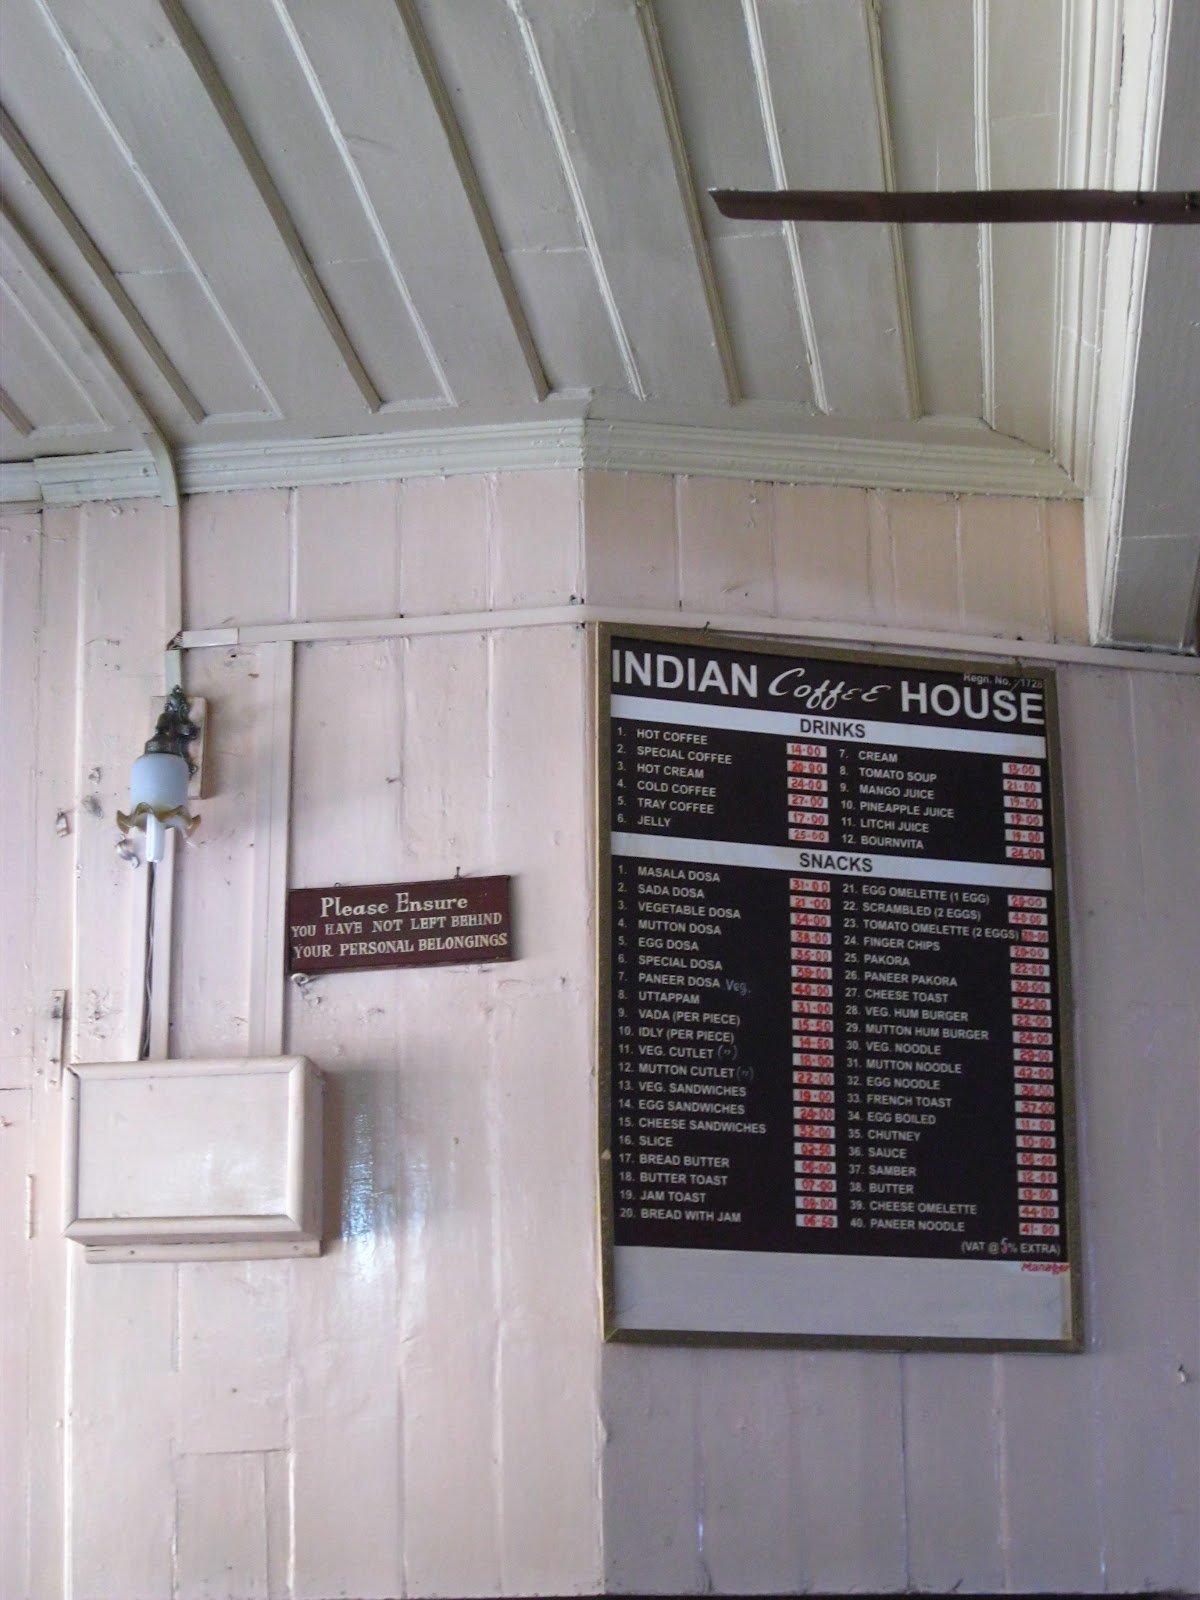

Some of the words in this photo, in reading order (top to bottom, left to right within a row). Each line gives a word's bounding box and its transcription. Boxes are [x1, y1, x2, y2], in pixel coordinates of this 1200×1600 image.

[612, 649, 758, 698] INDIAN
[901, 680, 1045, 725] HOUSE
[617, 727, 626, 736] 1.
[637, 729, 661, 740] HOT
[663, 731, 708, 745] COFFEE
[800, 719, 866, 739] DRINKS
[617, 744, 626, 754] 2.
[637, 746, 685, 760] SPECIAL
[687, 751, 732, 765] COFFEE
[839, 749, 848, 759] 7.
[858, 750, 898, 763] CREAM
[617, 762, 626, 771] 3.
[637, 763, 661, 775] HOT
[663, 766, 704, 779] CREAM
[839, 766, 848, 775] 8.
[859, 767, 904, 781] TOMATO
[907, 771, 937, 783] SOUP
[617, 779, 626, 788] 4.
[637, 781, 668, 793] COLD
[671, 784, 717, 797] COFFEE
[840, 783, 849, 793] 9.
[859, 784, 901, 797] MANGO
[903, 788, 934, 800] JUICE
[617, 796, 626, 806] 5.
[637, 798, 667, 810] TRAY
[669, 801, 714, 814] COFFEE
[841, 800, 855, 810] 10.
[859, 801, 920, 816] PINEAPPLE
[923, 806, 955, 818] JUICE
[617, 814, 626, 823] 6.
[637, 816, 671, 828] JELLY
[841, 817, 856, 827] 11.
[860, 818, 895, 831] LITCHI
[898, 821, 929, 833] JUICE
[841, 834, 856, 844] 12.
[861, 836, 924, 849] BOURNVITA
[799, 852, 873, 874] SNACKS
[638, 866, 685, 881] MASALA
[688, 871, 721, 883] DOSA
[637, 884, 670, 897] SADA
[672, 887, 705, 899] DOSA
[862, 885, 886, 897] EGG
[889, 887, 947, 901] OMELETTE
[962, 891, 990, 906] EGG)
[320, 896, 389, 918] Please
[395, 892, 468, 914] Ensure
[638, 902, 706, 917] VEGETABLE
[708, 907, 741, 919] DOSA
[862, 902, 932, 917] SCRAMBLED
[946, 908, 981, 922] EGGS)
[291, 924, 316, 938] YOU
[325, 921, 363, 935] HAVE
[371, 919, 403, 933] NOT
[450, 912, 503, 928] BEHIND
[638, 920, 687, 933] MUTTON
[689, 924, 722, 936] DOSA
[863, 919, 909, 932] TOMATO
[912, 923, 970, 937] OMELETTE
[985, 927, 1019, 941] EGGS)
[293, 943, 332, 959] YOUR
[339, 939, 414, 956] PERSONAL
[418, 932, 508, 951] BELONGINGS
[638, 938, 663, 949] EGG
[666, 939, 699, 951] DOSA
[863, 936, 905, 949] FINGER
[907, 939, 941, 952] CHIPS
[638, 955, 688, 969] SPECIAL
[689, 959, 723, 971] DOSA
[864, 954, 911, 966] PAKORA
[638, 973, 686, 986] PANEER
[687, 976, 720, 988] DOSA
[864, 971, 909, 984] PANEER
[911, 974, 958, 987] PAKORA
[638, 991, 700, 1004] UTTAPPAM
[864, 989, 910, 1002] CHEESE
[912, 992, 949, 1003] TOAST
[638, 1009, 670, 1021] VADA
[672, 1011, 700, 1024] (PER
[703, 1013, 741, 1027] PIECE)
[864, 1006, 892, 1017] VEG.
[894, 1008, 920, 1020] HUM
[922, 1010, 969, 1023] BURGER
[638, 1027, 663, 1038] IDLY
[666, 1028, 694, 1041] (PER
[696, 1030, 735, 1044] PIECE)
[865, 1023, 913, 1036] MUTTON
[915, 1026, 940, 1038] HUM
[942, 1028, 989, 1041] BURGER
[638, 1045, 666, 1056] VEG.
[668, 1046, 714, 1059] CUTLET
[865, 1041, 892, 1053] VEG.
[895, 1043, 942, 1055] NOODLE
[638, 1063, 687, 1076] MUTTON
[690, 1066, 735, 1079] CUTLET
[865, 1059, 913, 1071] MUTTON
[915, 1061, 963, 1074] NOODLE
[638, 1081, 666, 1093] VEG.
[669, 1083, 747, 1097] SANDWICHES
[866, 1076, 891, 1088] EGG
[894, 1078, 941, 1090] NOODLE
[638, 1099, 664, 1111] EGG
[667, 1101, 745, 1115] SANDWICHES
[866, 1094, 913, 1107] FRENCH
[915, 1096, 953, 1108] TOAST
[638, 1117, 686, 1130] CHEESE
[689, 1119, 767, 1134] SANDWICHES
[867, 1111, 893, 1123] EGG
[894, 1113, 937, 1125] BOILED
[638, 1136, 673, 1148] SLICE
[867, 1129, 922, 1142] CHUTNEY
[867, 1147, 907, 1159] SAUCE
[639, 1154, 681, 1167] BREAD
[683, 1156, 730, 1169] BUTTER
[868, 1164, 917, 1177] SAMBER
[639, 1172, 686, 1185] BUTTER
[688, 1174, 728, 1186] TOAST
[640, 1190, 665, 1202] JAM
[668, 1192, 707, 1203] TOAST
[868, 1182, 914, 1195] BUTTER
[640, 1208, 682, 1221] BREAD
[685, 1210, 714, 1222] WITH
[716, 1211, 741, 1223] JAM
[869, 1200, 915, 1213] CHEESE
[917, 1202, 978, 1215] OMELETTE
[870, 1218, 916, 1230] PANEER
[918, 1220, 965, 1232] NOODLE
[961, 1241, 985, 1254] (VAT
[1020, 1243, 1061, 1255] EXTRA)
